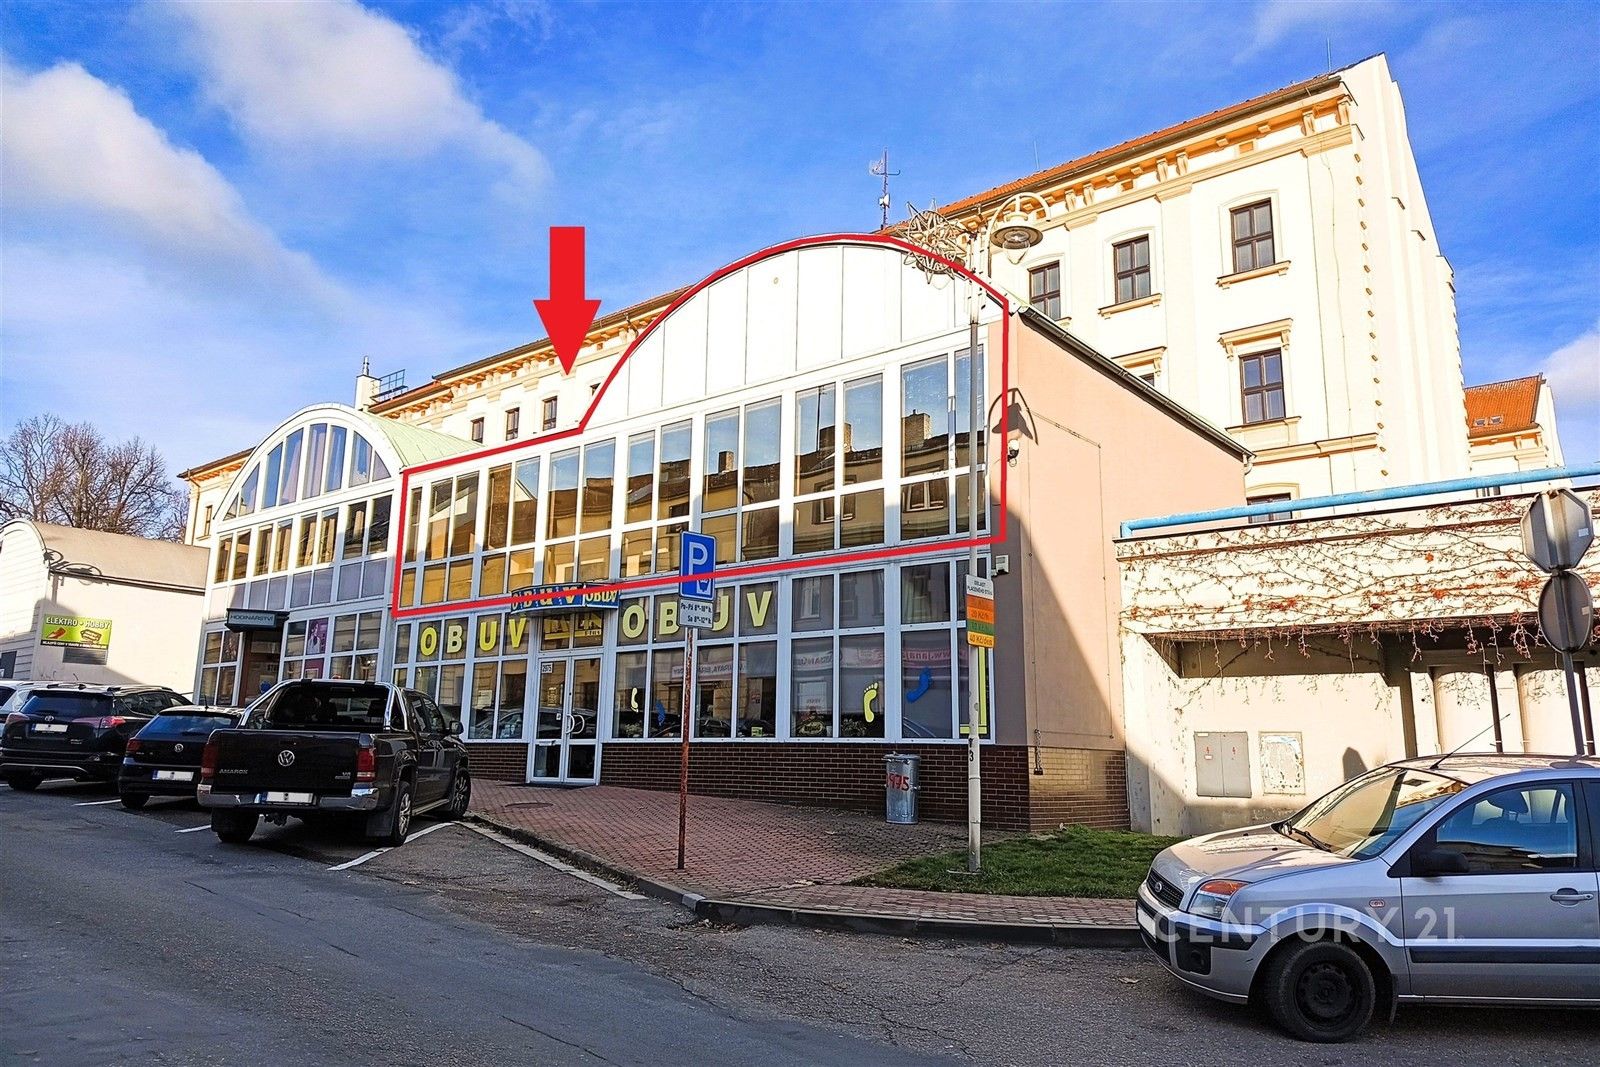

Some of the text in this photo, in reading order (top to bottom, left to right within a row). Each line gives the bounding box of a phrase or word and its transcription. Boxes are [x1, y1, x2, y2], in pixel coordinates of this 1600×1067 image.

[688, 541, 708, 576] P
[46, 616, 110, 629] ELEKTRO HOBBY
[420, 617, 527, 656] OBUV
